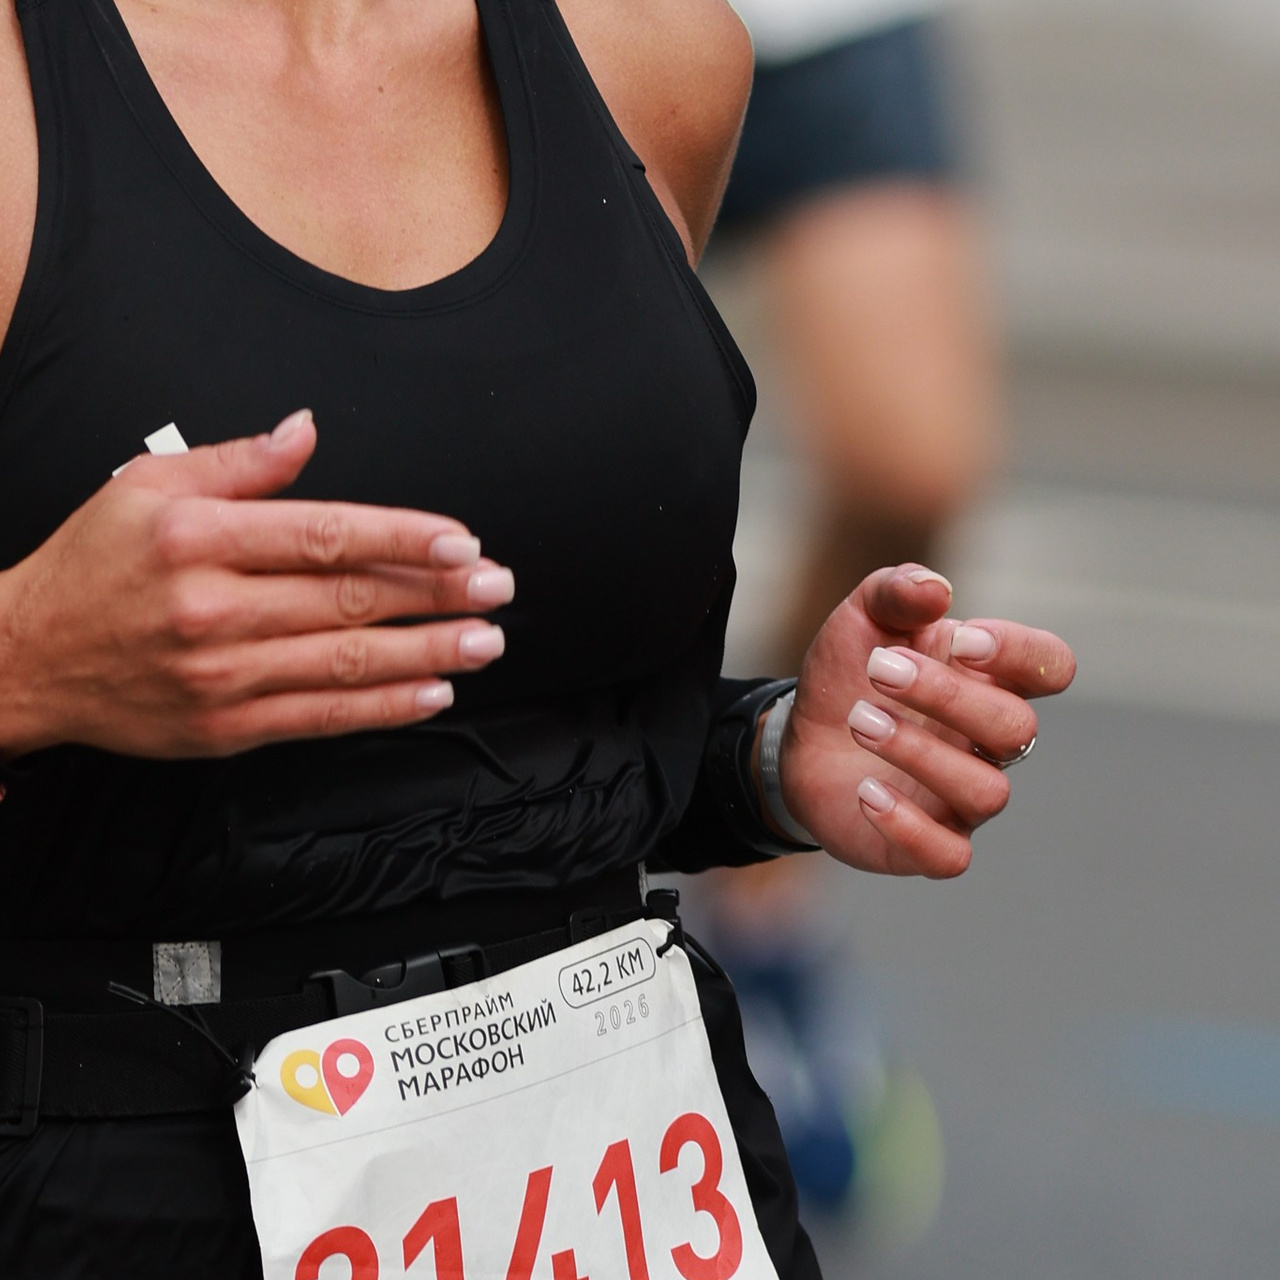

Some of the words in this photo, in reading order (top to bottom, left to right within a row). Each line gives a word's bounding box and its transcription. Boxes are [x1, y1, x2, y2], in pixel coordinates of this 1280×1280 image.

[572, 962, 612, 996] 42,2
[616, 948, 645, 980] КМ
[384, 991, 514, 1043] СБЕРПРАЙМ
[390, 998, 557, 1072] МОСКОВСКИЙ
[595, 994, 650, 1036] 2026
[397, 1044, 525, 1101] МАРАФОН
